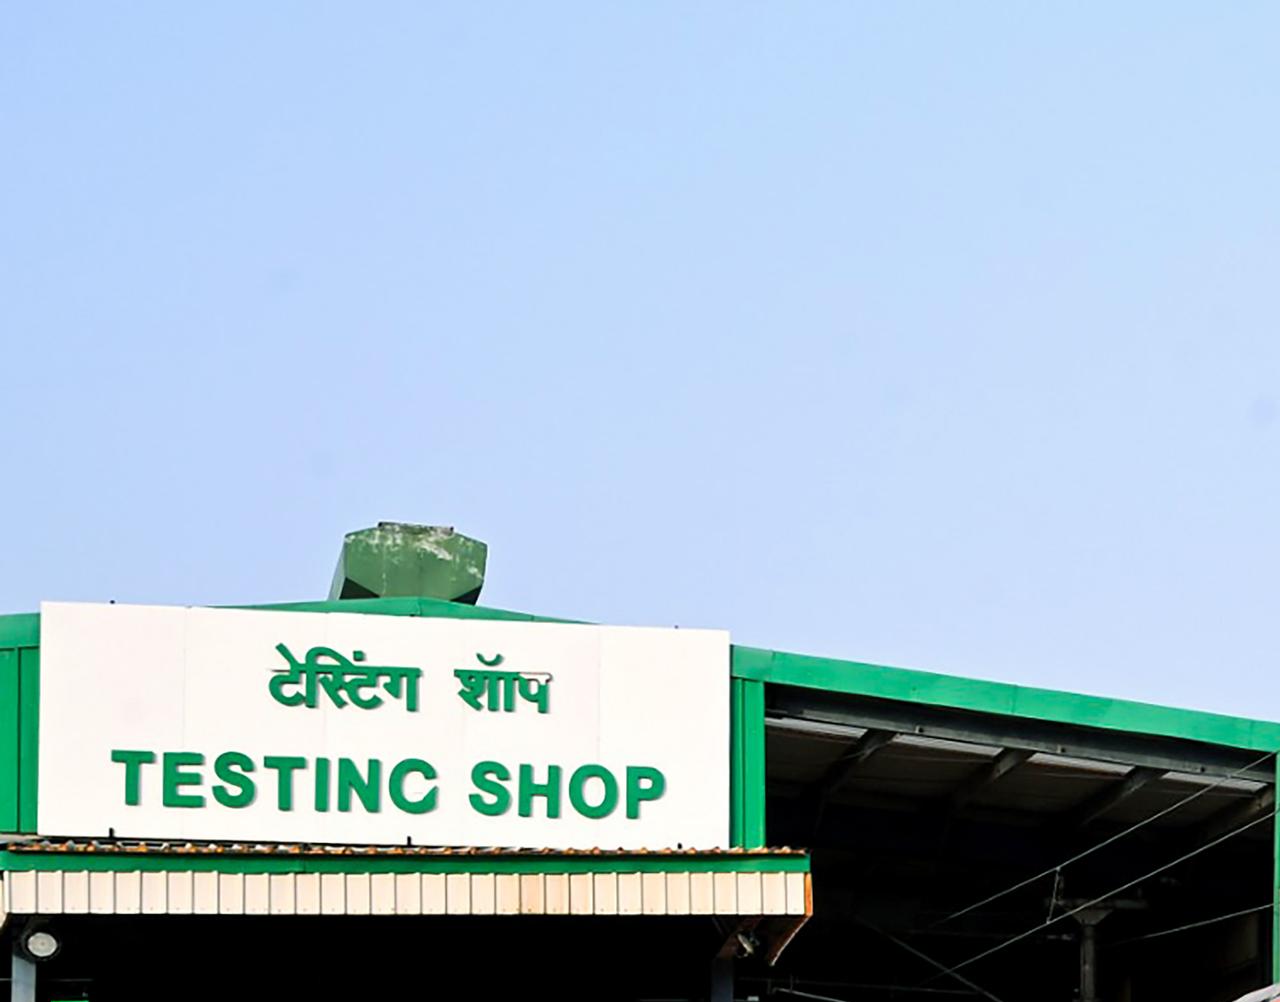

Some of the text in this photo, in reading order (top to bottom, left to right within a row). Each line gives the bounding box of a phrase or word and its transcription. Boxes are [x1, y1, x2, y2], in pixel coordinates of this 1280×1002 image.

[268, 642, 553, 714] टेस्टिंग शॉप
[469, 760, 667, 820] SHOP
